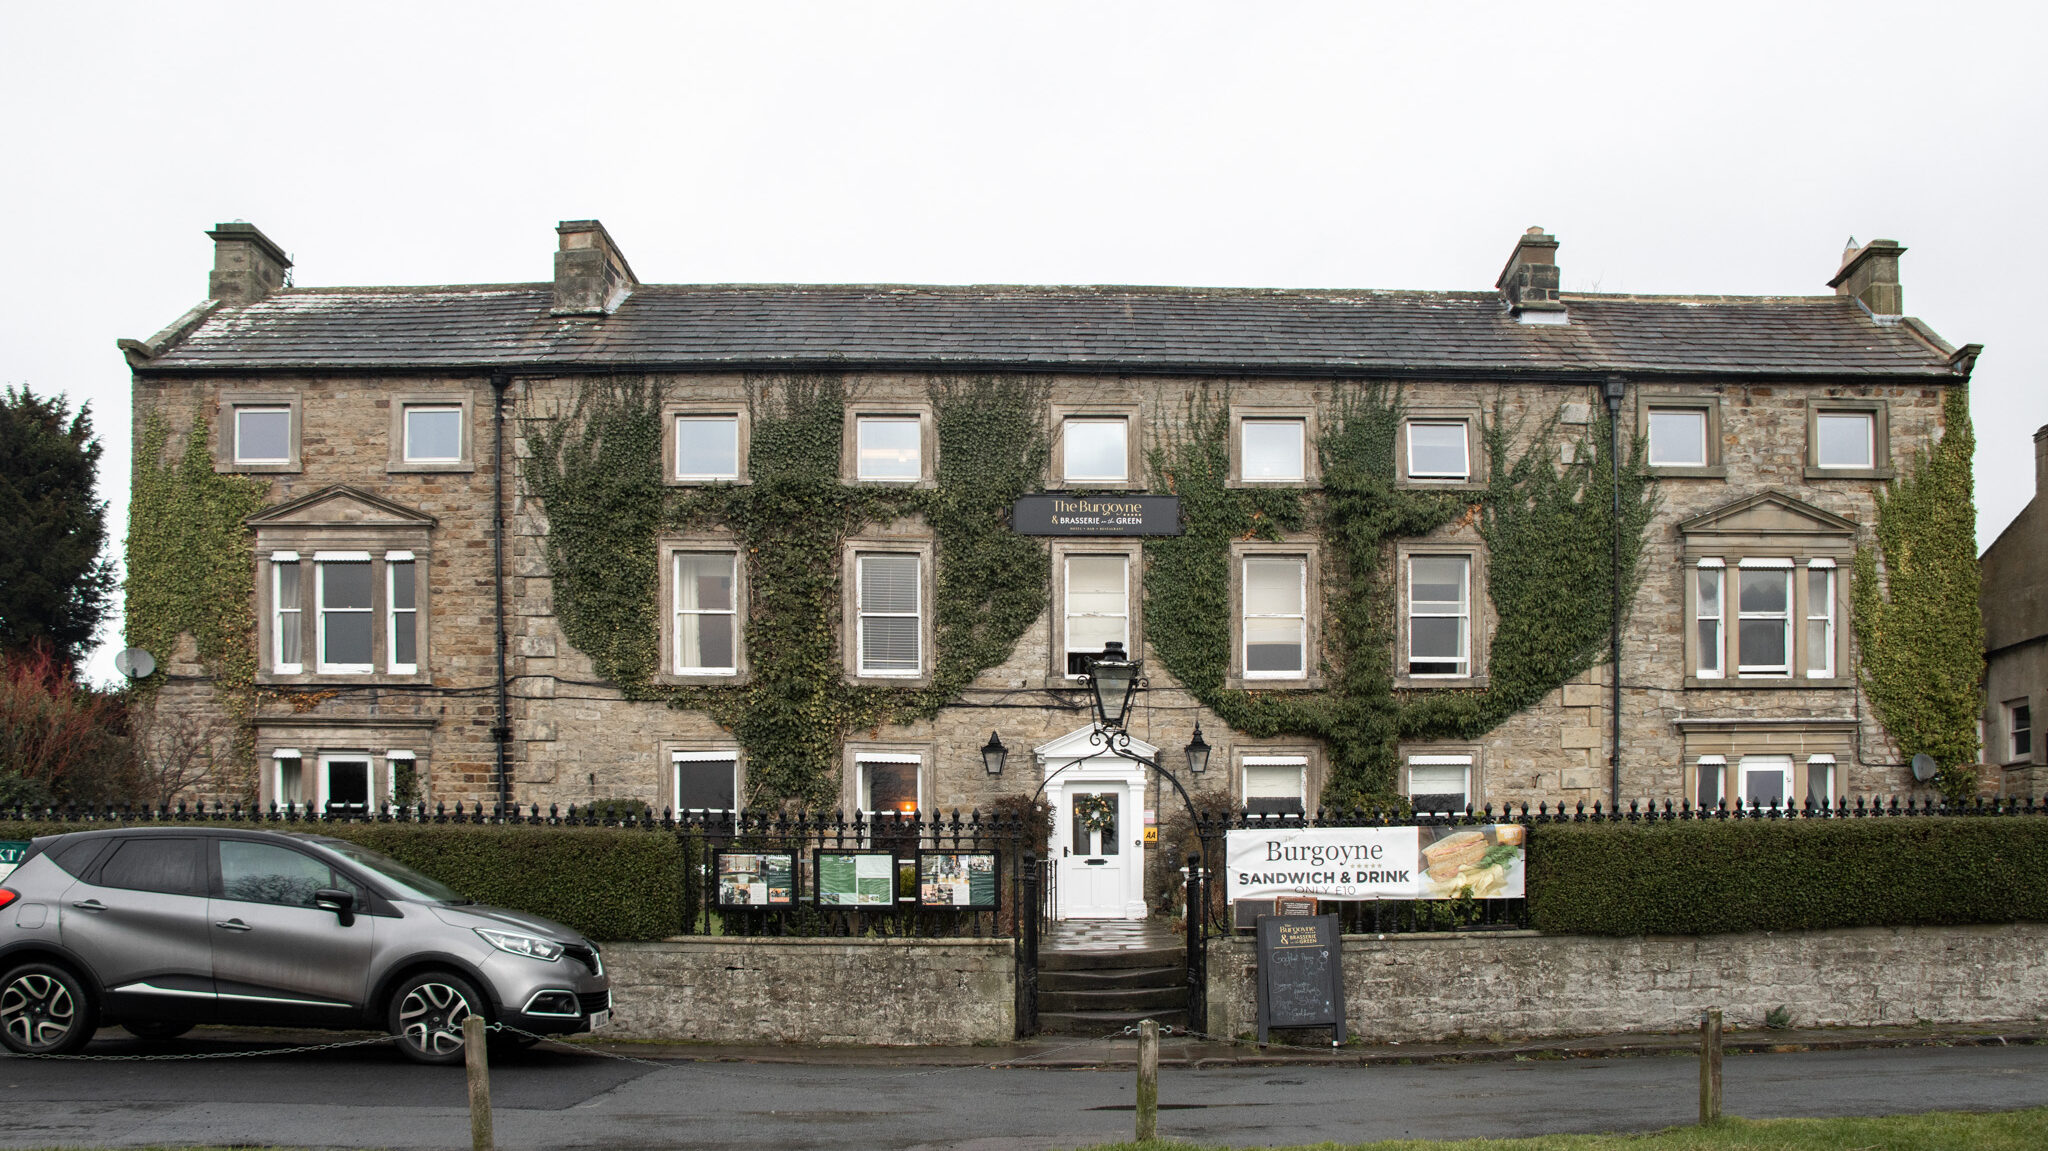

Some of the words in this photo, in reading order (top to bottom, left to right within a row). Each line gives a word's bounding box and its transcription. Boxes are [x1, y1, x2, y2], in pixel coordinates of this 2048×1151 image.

[1052, 500, 1077, 513] The
[1080, 500, 1142, 516] Burgoyne
[1051, 514, 1059, 525] &
[1060, 517, 1100, 525] BRASSERIE
[1145, 831, 1156, 839] AA
[1265, 841, 1383, 866] Burgoyne
[1239, 871, 1335, 885] SANDWICH
[1340, 871, 1351, 884] &
[1356, 870, 1410, 883] DRINK
[1294, 886, 1330, 895] ONLY
[1280, 934, 1289, 945] &
